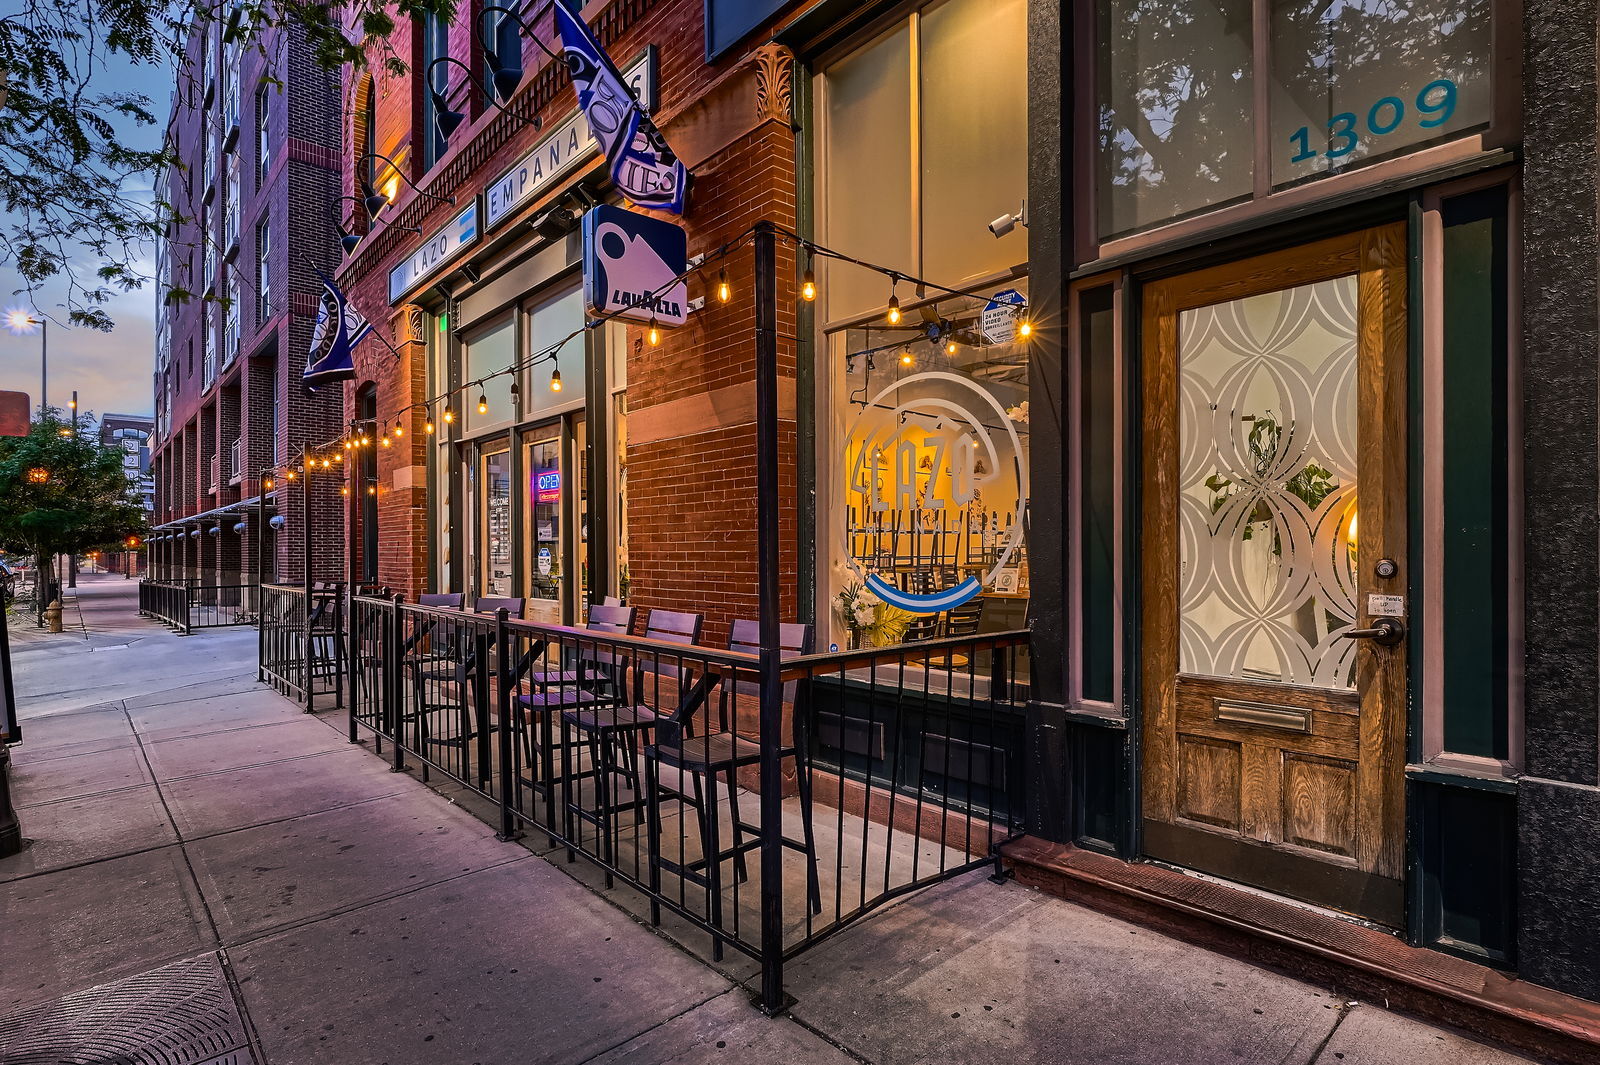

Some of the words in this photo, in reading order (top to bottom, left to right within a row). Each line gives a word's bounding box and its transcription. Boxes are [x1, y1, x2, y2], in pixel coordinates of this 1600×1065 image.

[1289, 79, 1458, 164] 1309
[491, 74, 641, 216] EMPANAS
[413, 234, 448, 277] LAZO
[612, 289, 682, 318] LAVAZZA
[992, 309, 1008, 318] HOUR
[985, 317, 1001, 325] VIDEO
[871, 432, 975, 512] LAZO
[490, 497, 509, 507] WELCOME
[852, 517, 999, 537] EMPANADAS
